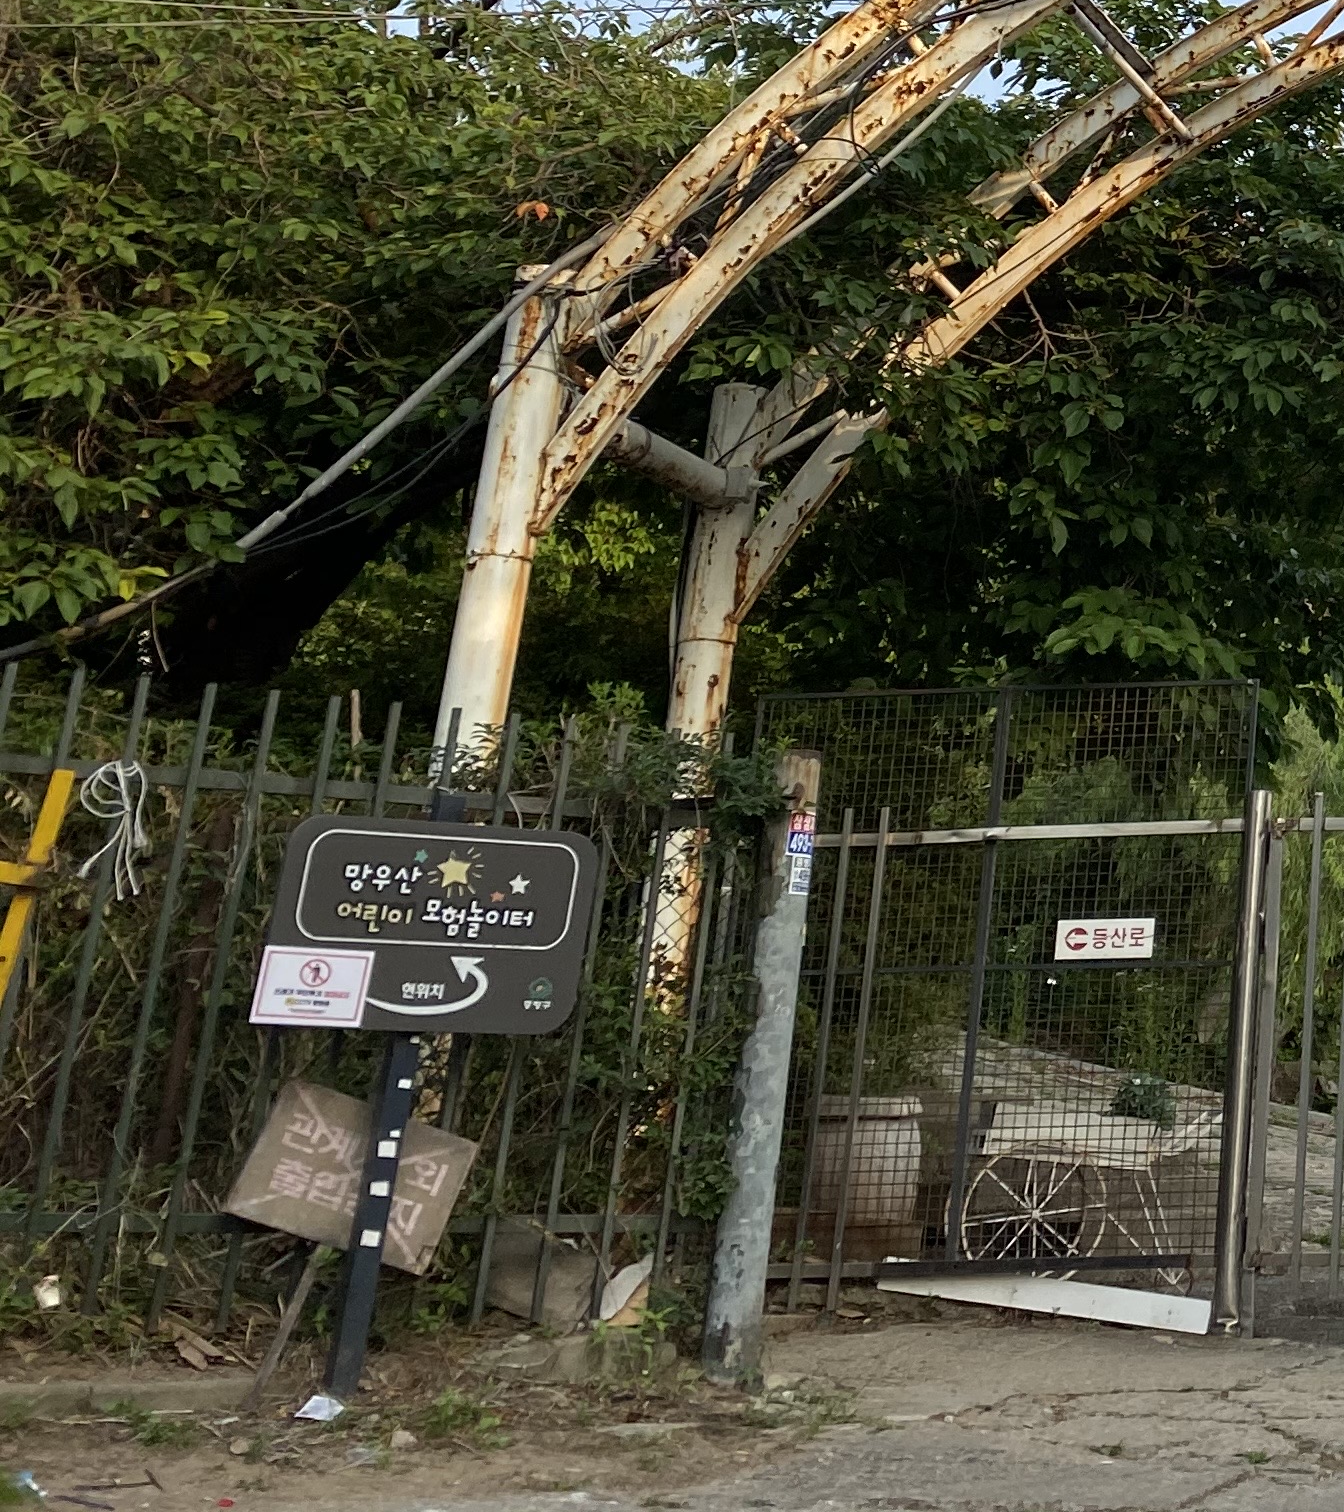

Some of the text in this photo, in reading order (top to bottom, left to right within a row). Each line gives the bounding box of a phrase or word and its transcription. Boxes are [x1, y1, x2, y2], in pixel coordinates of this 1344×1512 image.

[344, 863, 425, 895] 망우산
[337, 898, 535, 940] 어린이 모험놀이터
[1092, 927, 1145, 949] 등산로
[401, 980, 445, 1000] 현위치
[281, 1112, 450, 1197] 관계외
